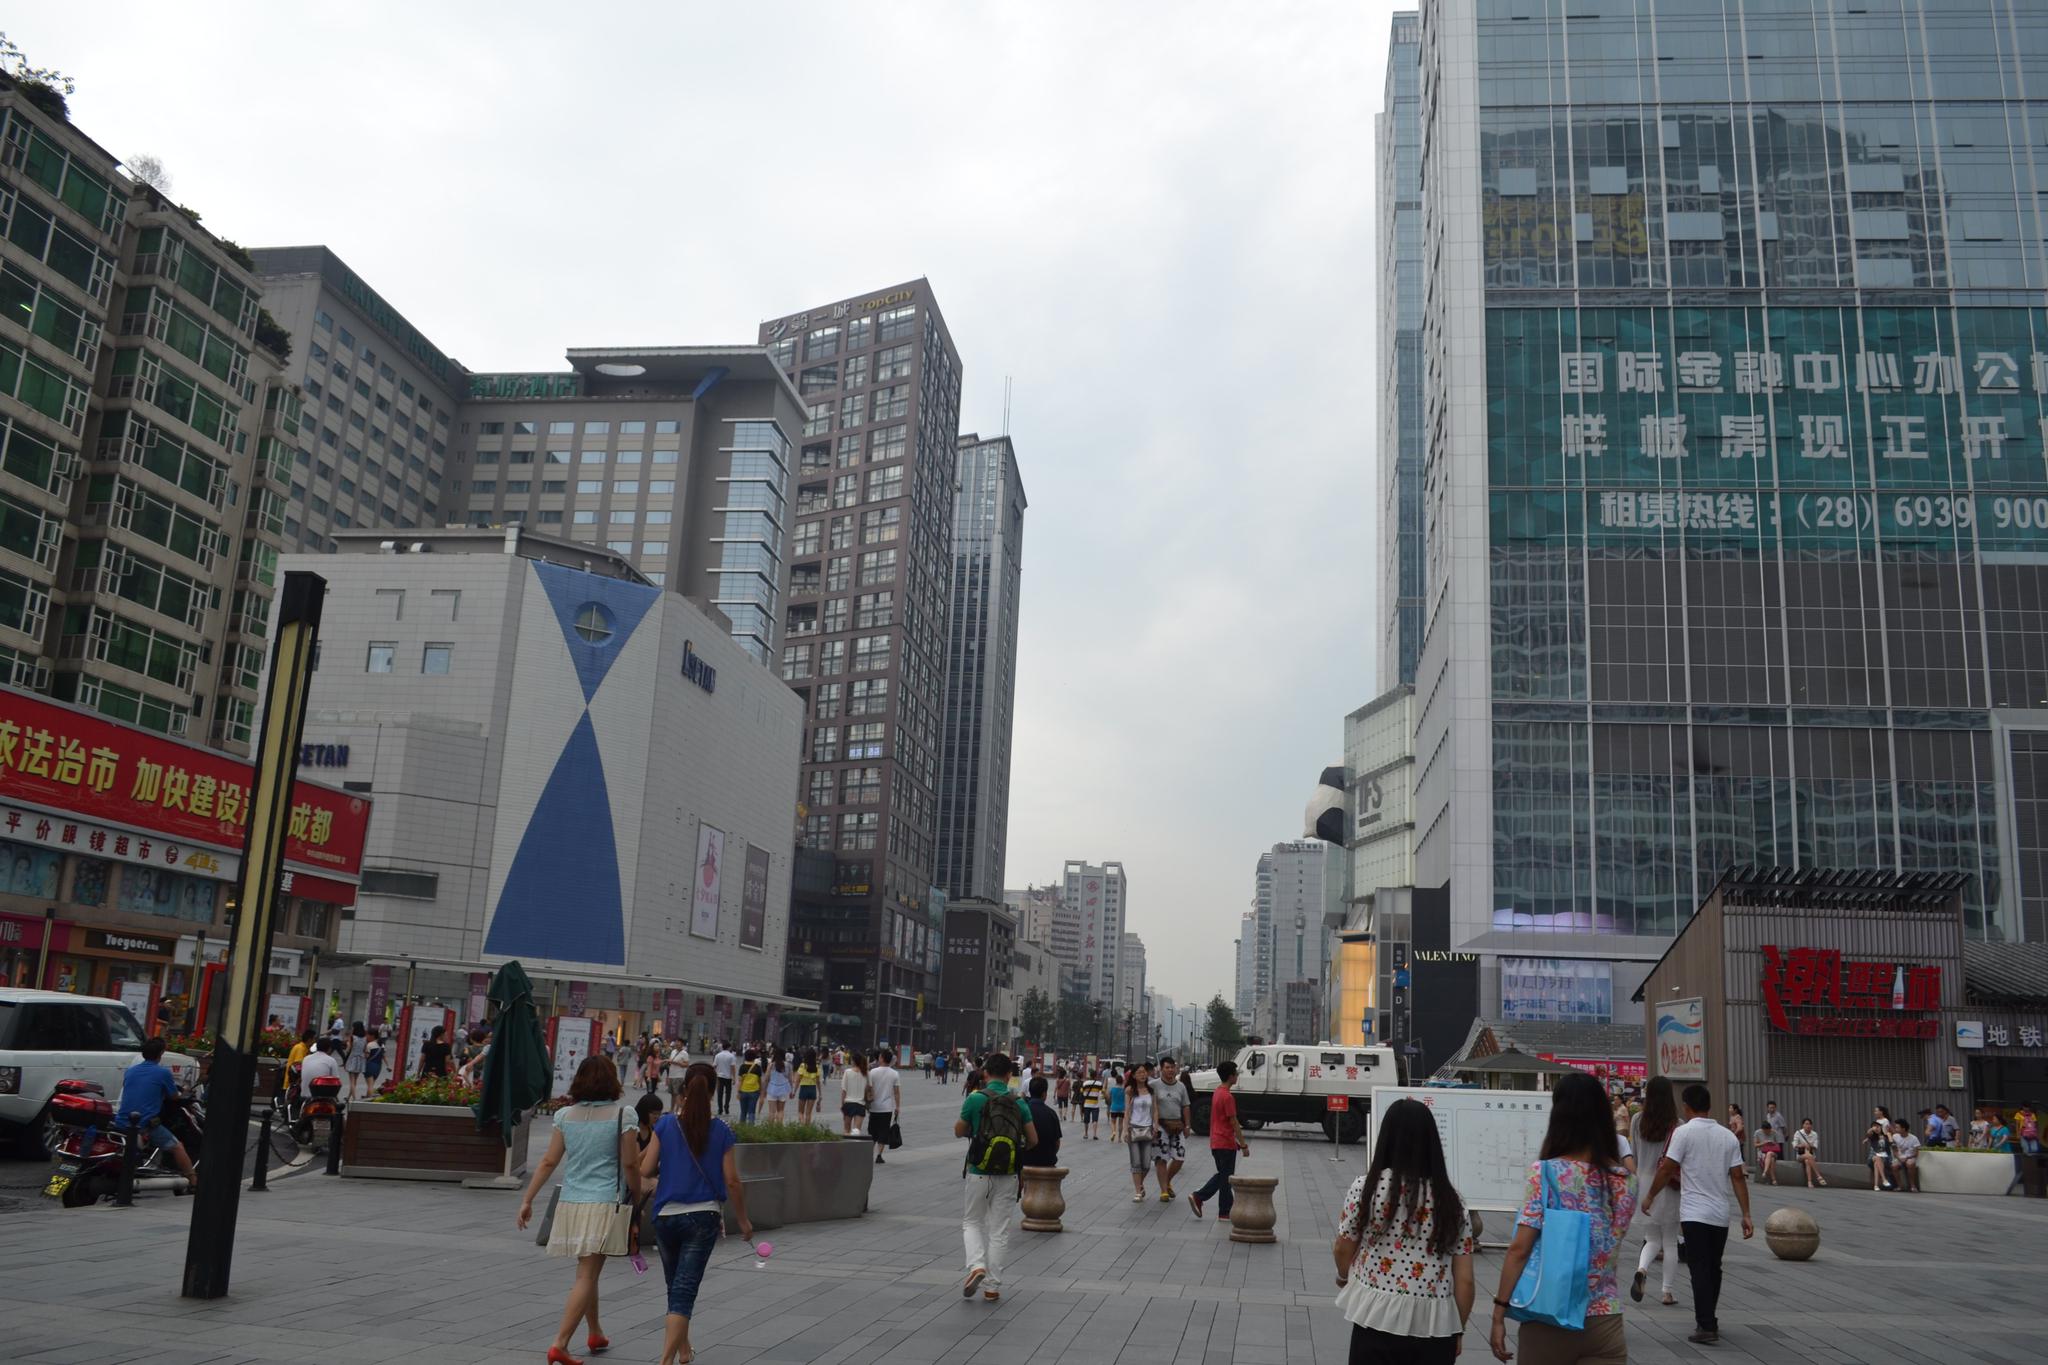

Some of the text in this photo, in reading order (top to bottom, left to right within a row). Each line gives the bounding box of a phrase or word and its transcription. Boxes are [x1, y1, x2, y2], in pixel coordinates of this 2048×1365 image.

[1894, 495, 1972, 528] 6939
[300, 744, 350, 768] ETAN
[1359, 775, 1382, 815] IFS
[5, 811, 152, 860] 平价眼镜超市
[1413, 949, 1476, 961] VALENTINO
[1986, 1024, 2044, 1048] 地铁
[1670, 1044, 1701, 1066] 地铁入口
[1309, 1064, 1359, 1081] 武警
[1484, 1102, 1543, 1111] 交通示意图
